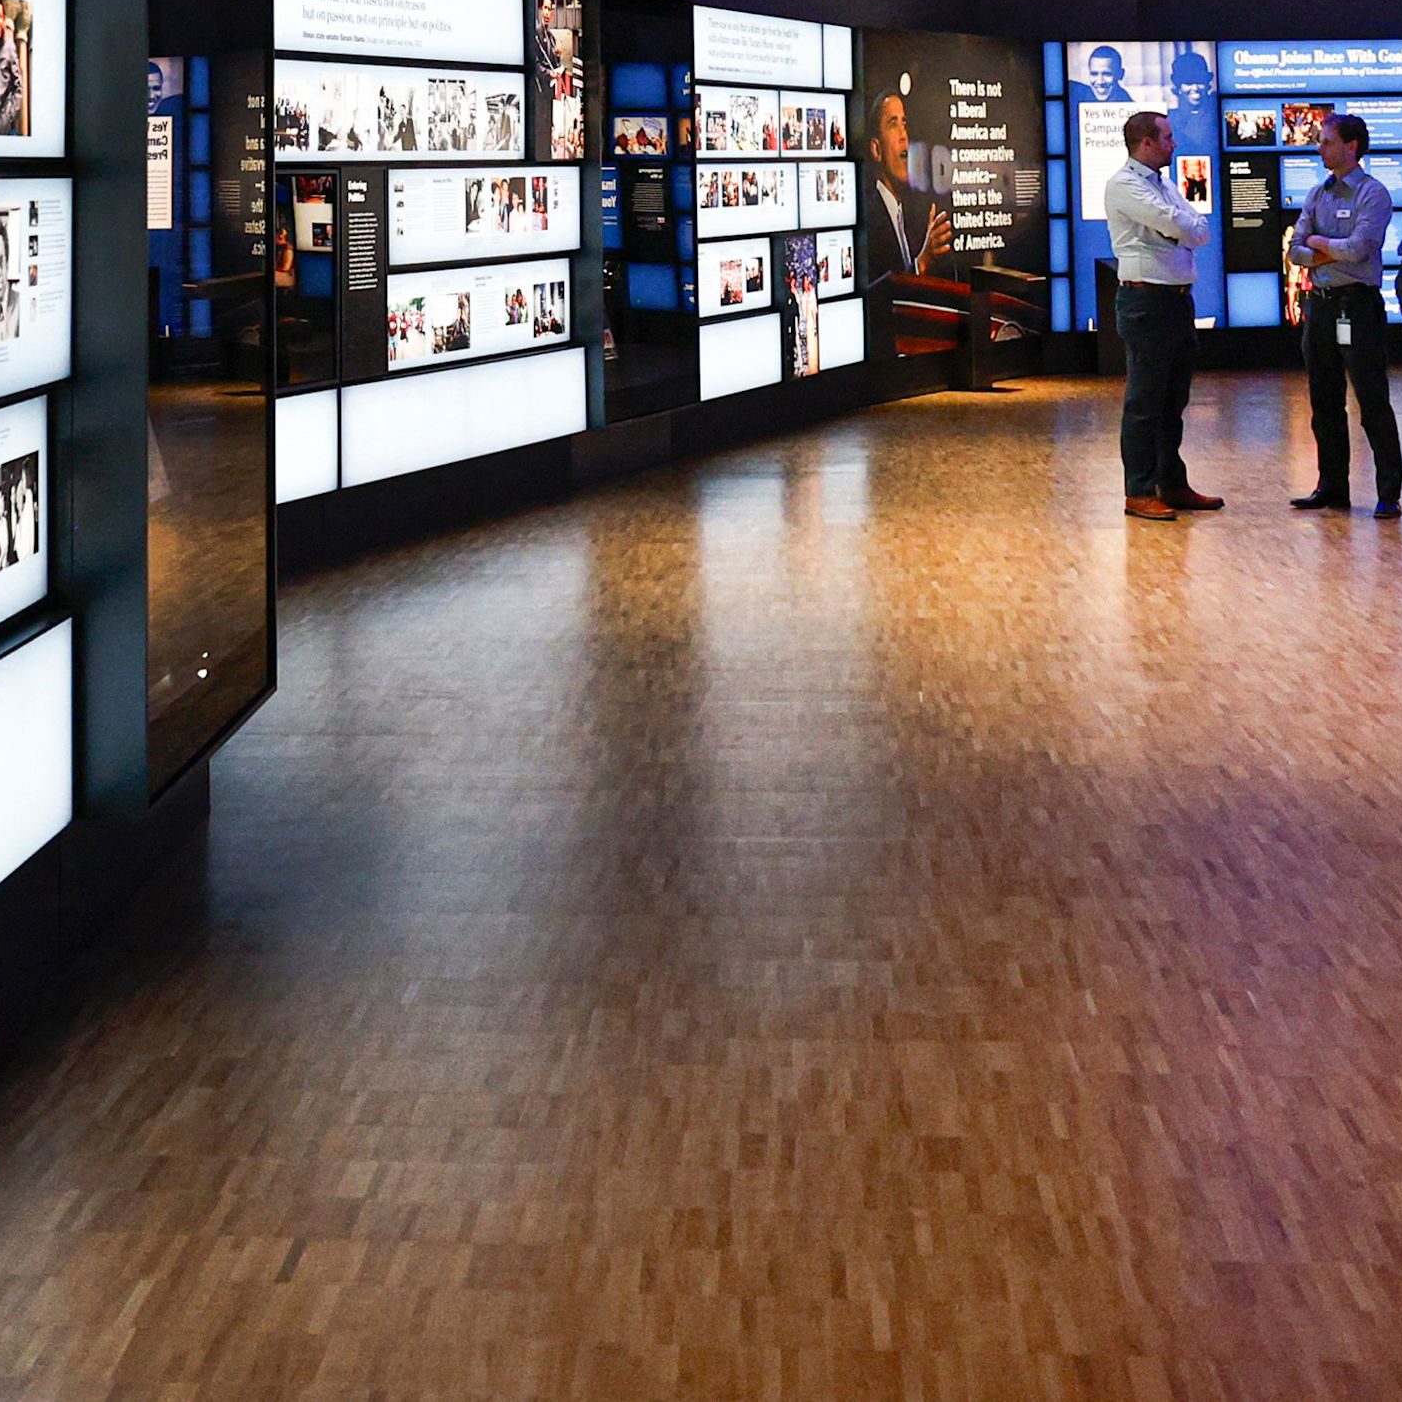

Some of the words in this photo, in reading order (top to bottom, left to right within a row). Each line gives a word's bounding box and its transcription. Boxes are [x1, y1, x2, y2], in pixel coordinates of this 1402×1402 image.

[1234, 50, 1278, 64] Obama
[1279, 50, 1312, 67] Joins
[1314, 50, 1344, 64] Race
[1346, 49, 1376, 63] With
[949, 79, 976, 96] There
[977, 80, 985, 96] is
[986, 82, 1002, 98] not
[950, 105, 956, 118] a
[958, 102, 986, 118] liberal
[1084, 108, 1100, 118] Yes
[1102, 108, 1116, 118] We
[951, 124, 988, 140] America
[990, 124, 1006, 140] and
[1084, 122, 1124, 134] Campai
[1086, 137, 1126, 148] Presiden
[952, 149, 958, 162] a
[959, 146, 1014, 162] conservative
[952, 190, 978, 206] there
[978, 189, 987, 205] is
[988, 190, 1002, 204] the
[953, 212, 984, 229] United
[984, 212, 1012, 227] States
[954, 235, 964, 252] of
[966, 233, 1004, 250] America.
